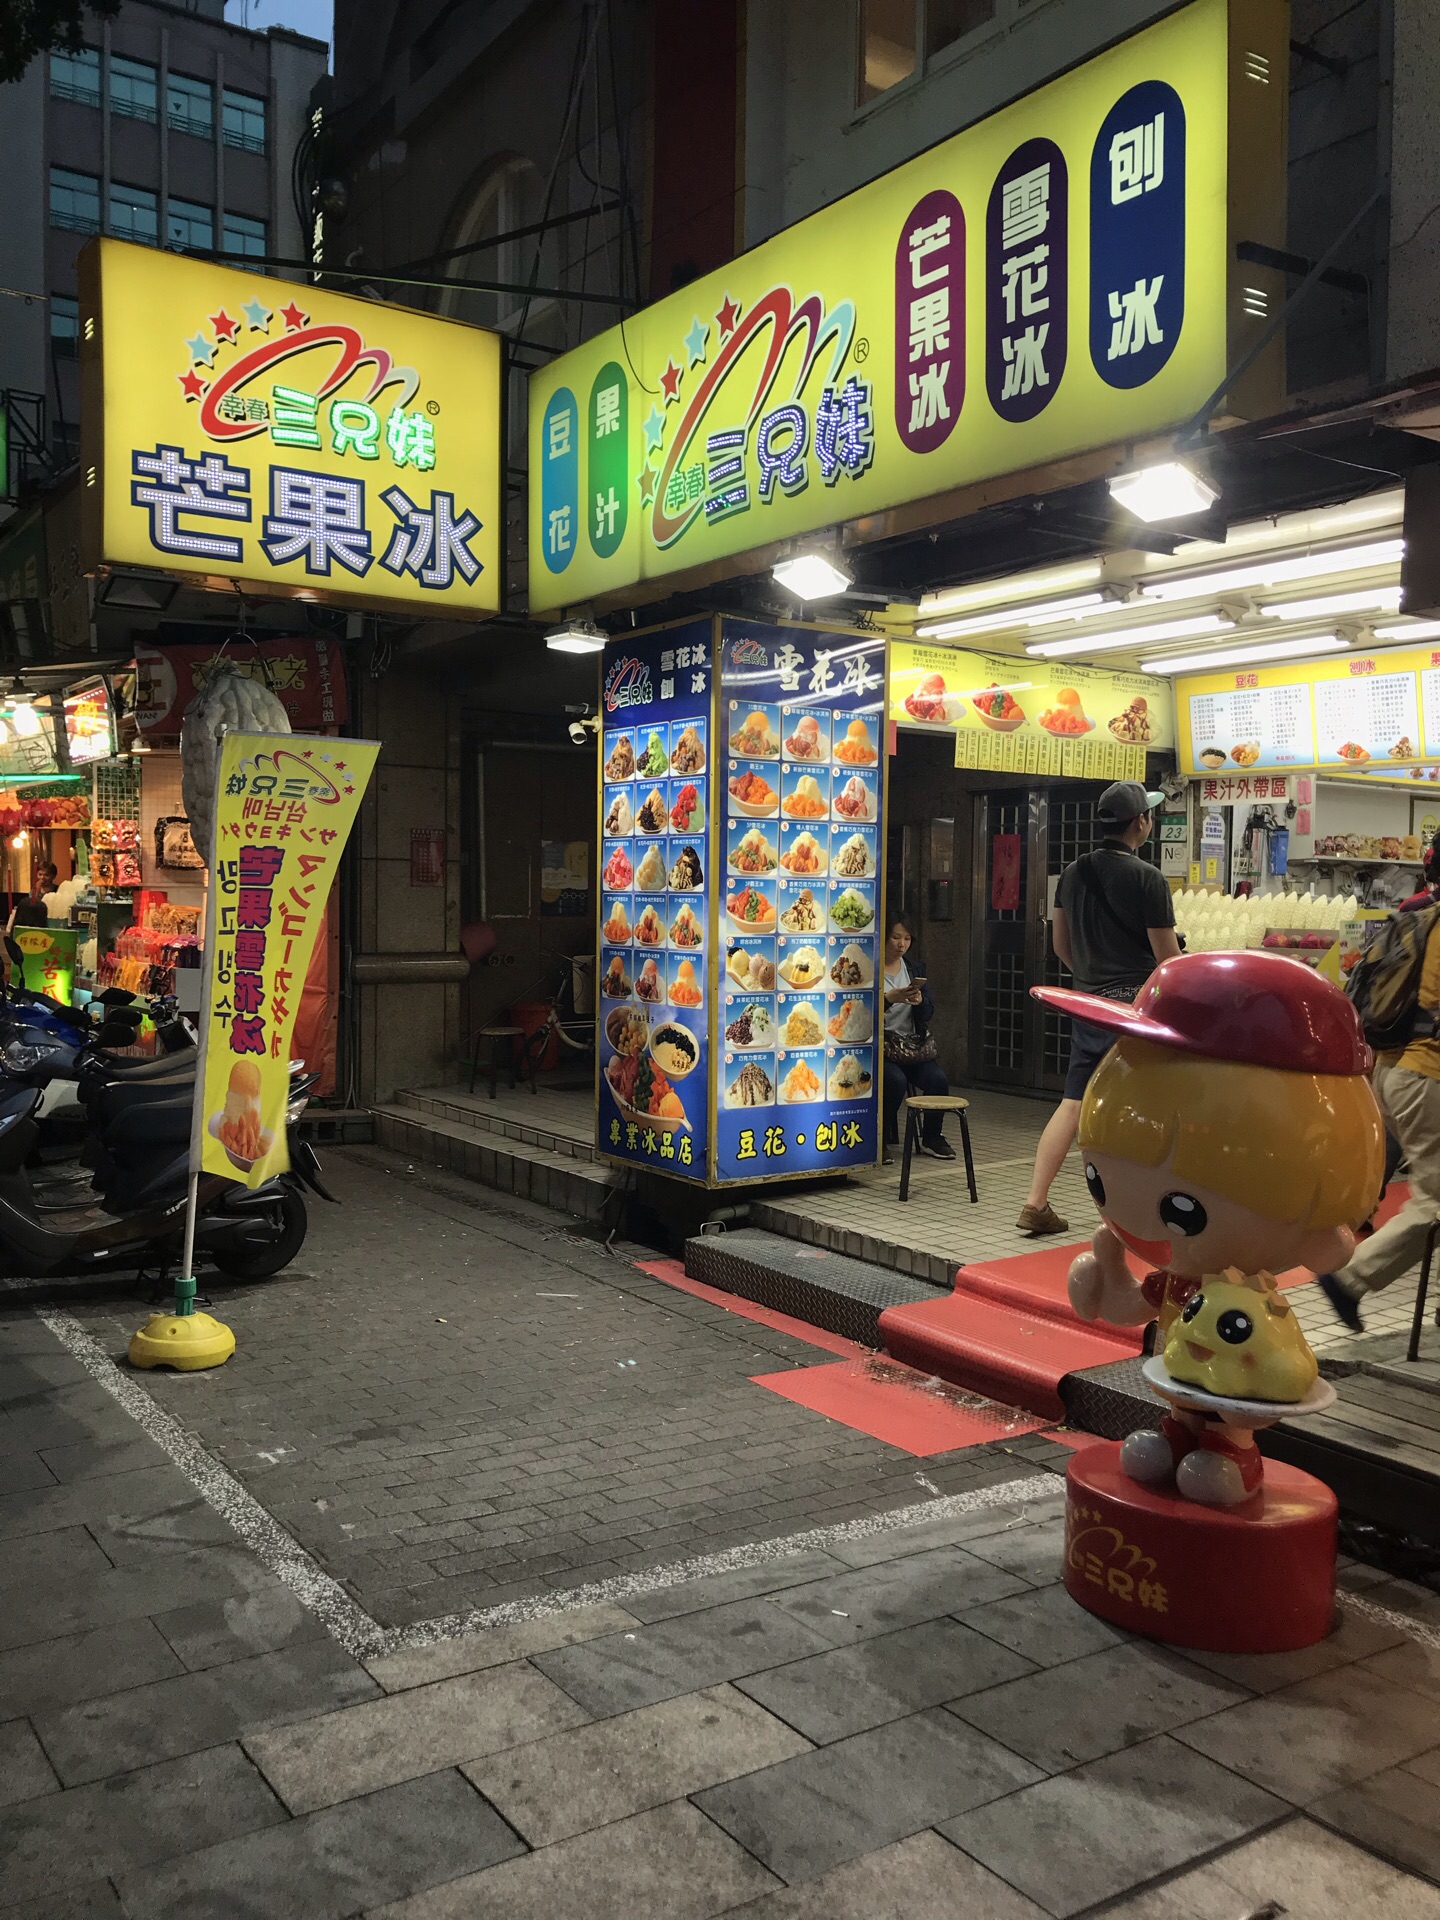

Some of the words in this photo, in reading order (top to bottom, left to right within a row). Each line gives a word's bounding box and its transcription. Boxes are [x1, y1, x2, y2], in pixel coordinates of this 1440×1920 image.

[1107, 111, 1165, 361] 刨冰
[1001, 162, 1051, 402] 雪花冰
[908, 214, 951, 434] 芒果冰
[595, 383, 620, 539] 果汁
[548, 408, 572, 555] 豆花
[130, 443, 484, 591] 芒果冰
[660, 643, 707, 672] 雪花冰
[773, 643, 878, 697] 雪花冰
[1349, 659, 1376, 675] 刨冰
[660, 671, 707, 700] 刨冰
[1235, 673, 1258, 688] 豆花
[957, 730, 966, 759] 西瓜汁
[969, 730, 977, 762] 西瓜牛奶
[1203, 776, 1288, 801] 果汁外帶區
[1165, 827, 1183, 839] 23
[608, 1118, 694, 1166] 專業冰品店
